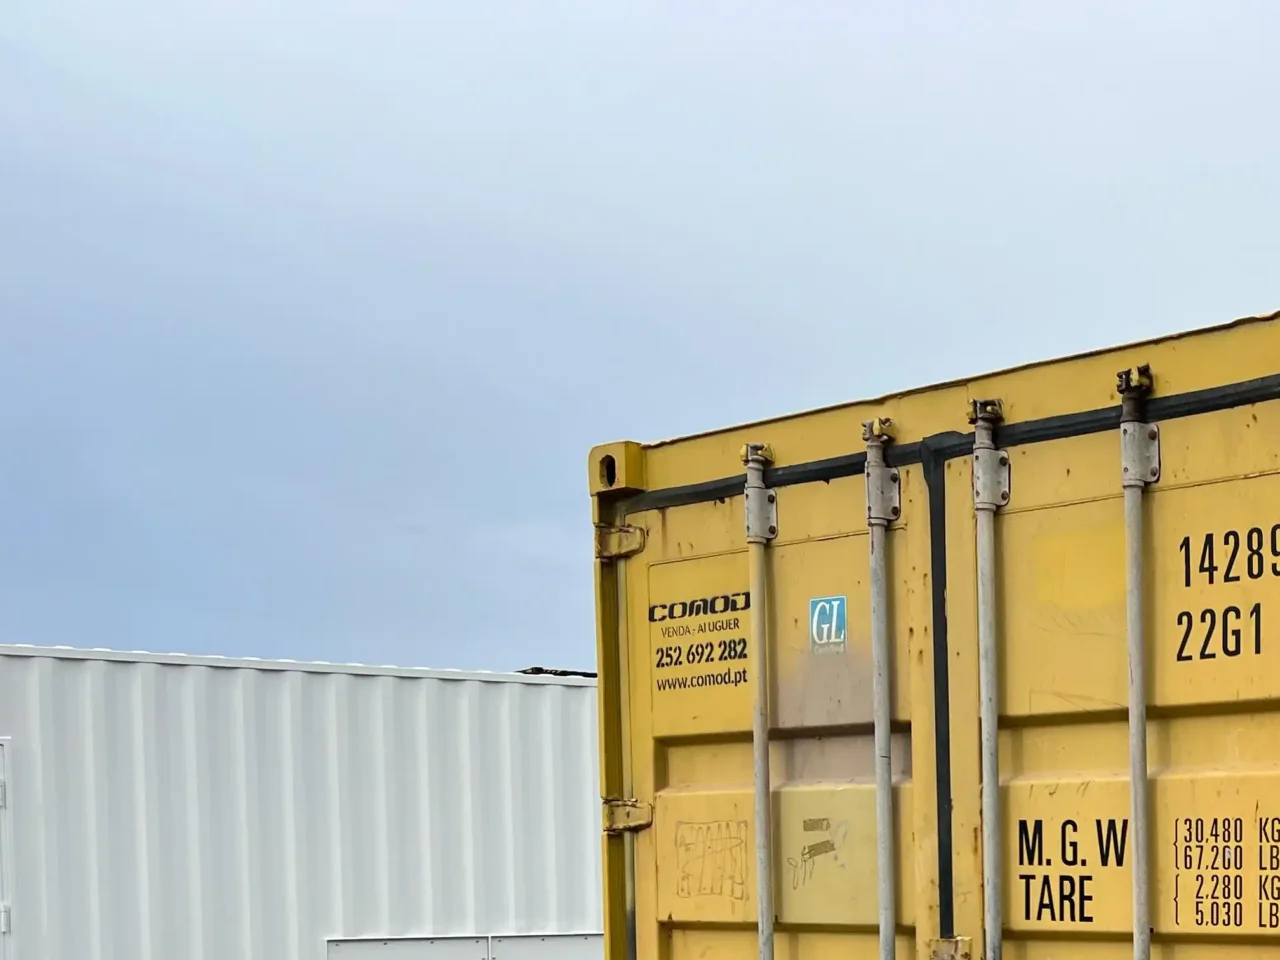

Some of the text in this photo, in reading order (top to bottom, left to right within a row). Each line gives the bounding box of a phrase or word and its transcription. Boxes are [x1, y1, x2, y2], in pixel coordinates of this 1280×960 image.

[648, 592, 751, 623] COMOD
[812, 600, 845, 644] GL
[661, 625, 692, 638] VENDA
[1176, 602, 1262, 662] 22G1
[656, 638, 748, 668] 252 692 282
[656, 667, 748, 692] www.comod.pt
[1019, 874, 1094, 923] TARE
